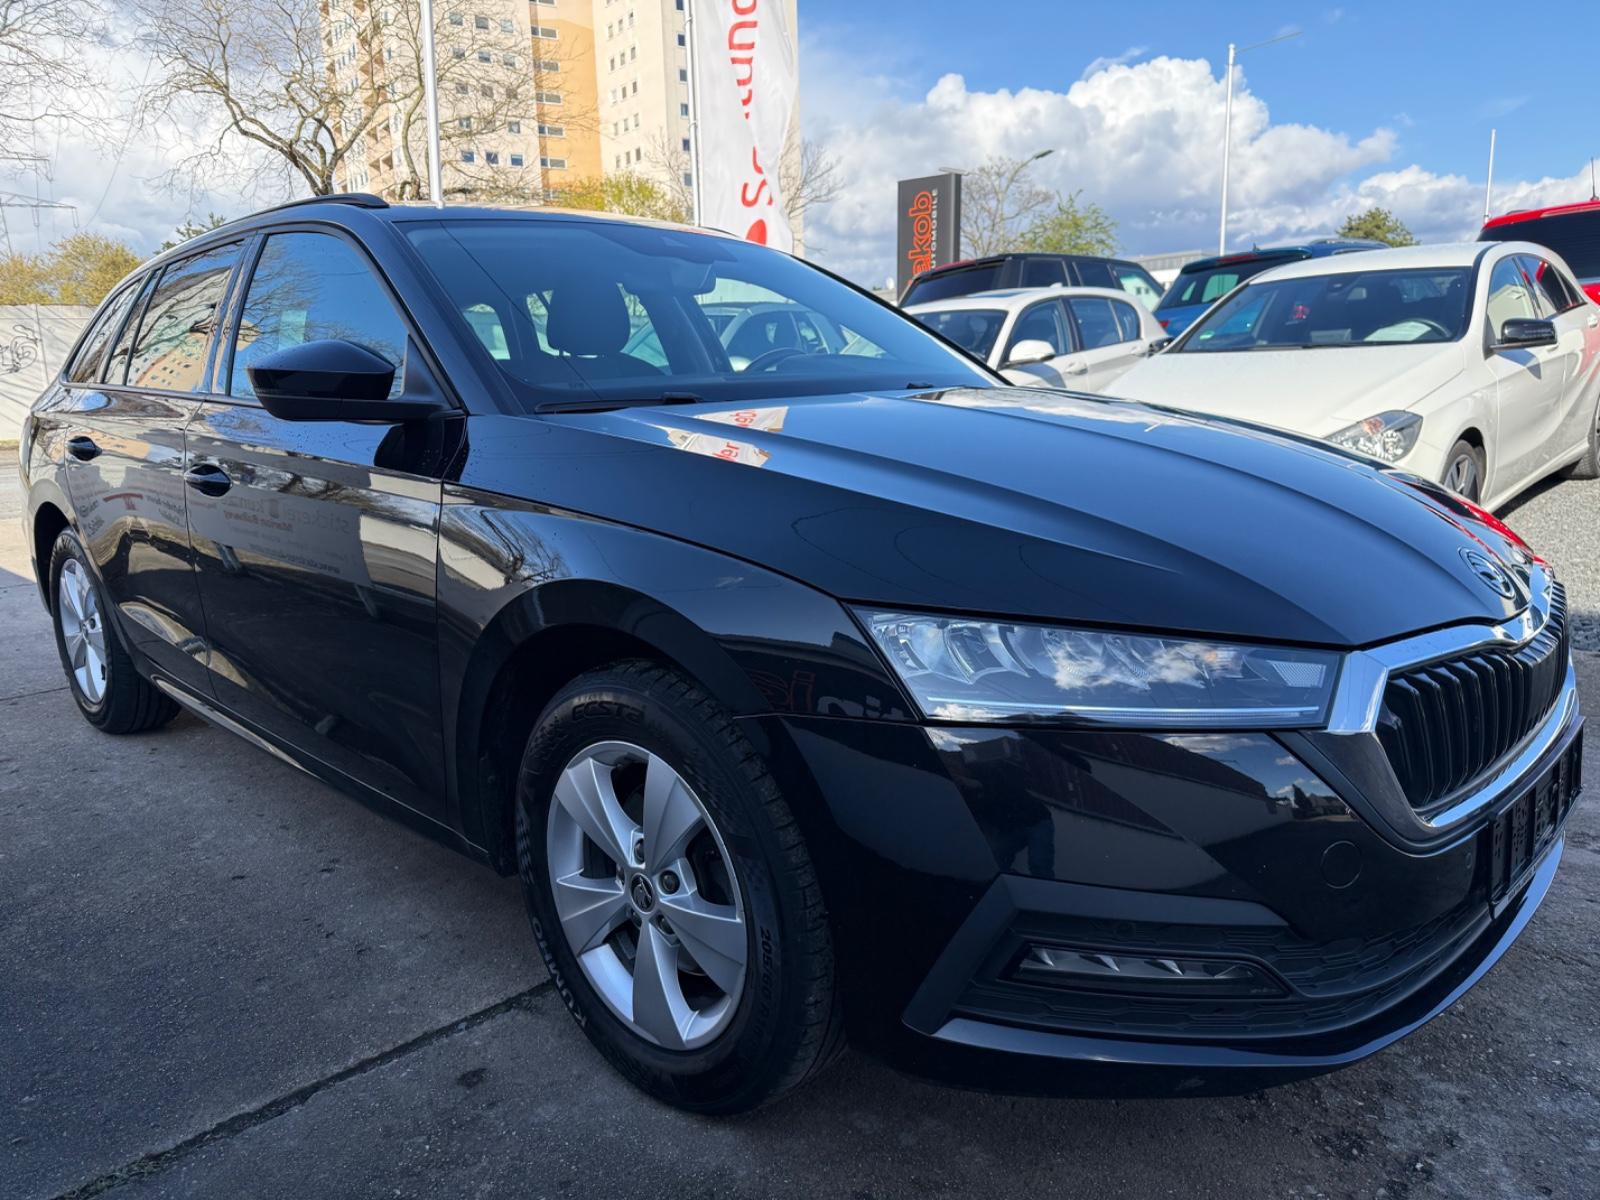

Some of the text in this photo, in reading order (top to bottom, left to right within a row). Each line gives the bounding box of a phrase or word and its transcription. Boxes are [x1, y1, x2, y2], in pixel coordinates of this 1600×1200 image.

[908, 191, 932, 285] akob
[930, 188, 938, 269] UTOMOBILE
[532, 916, 588, 1029] KUMHO
